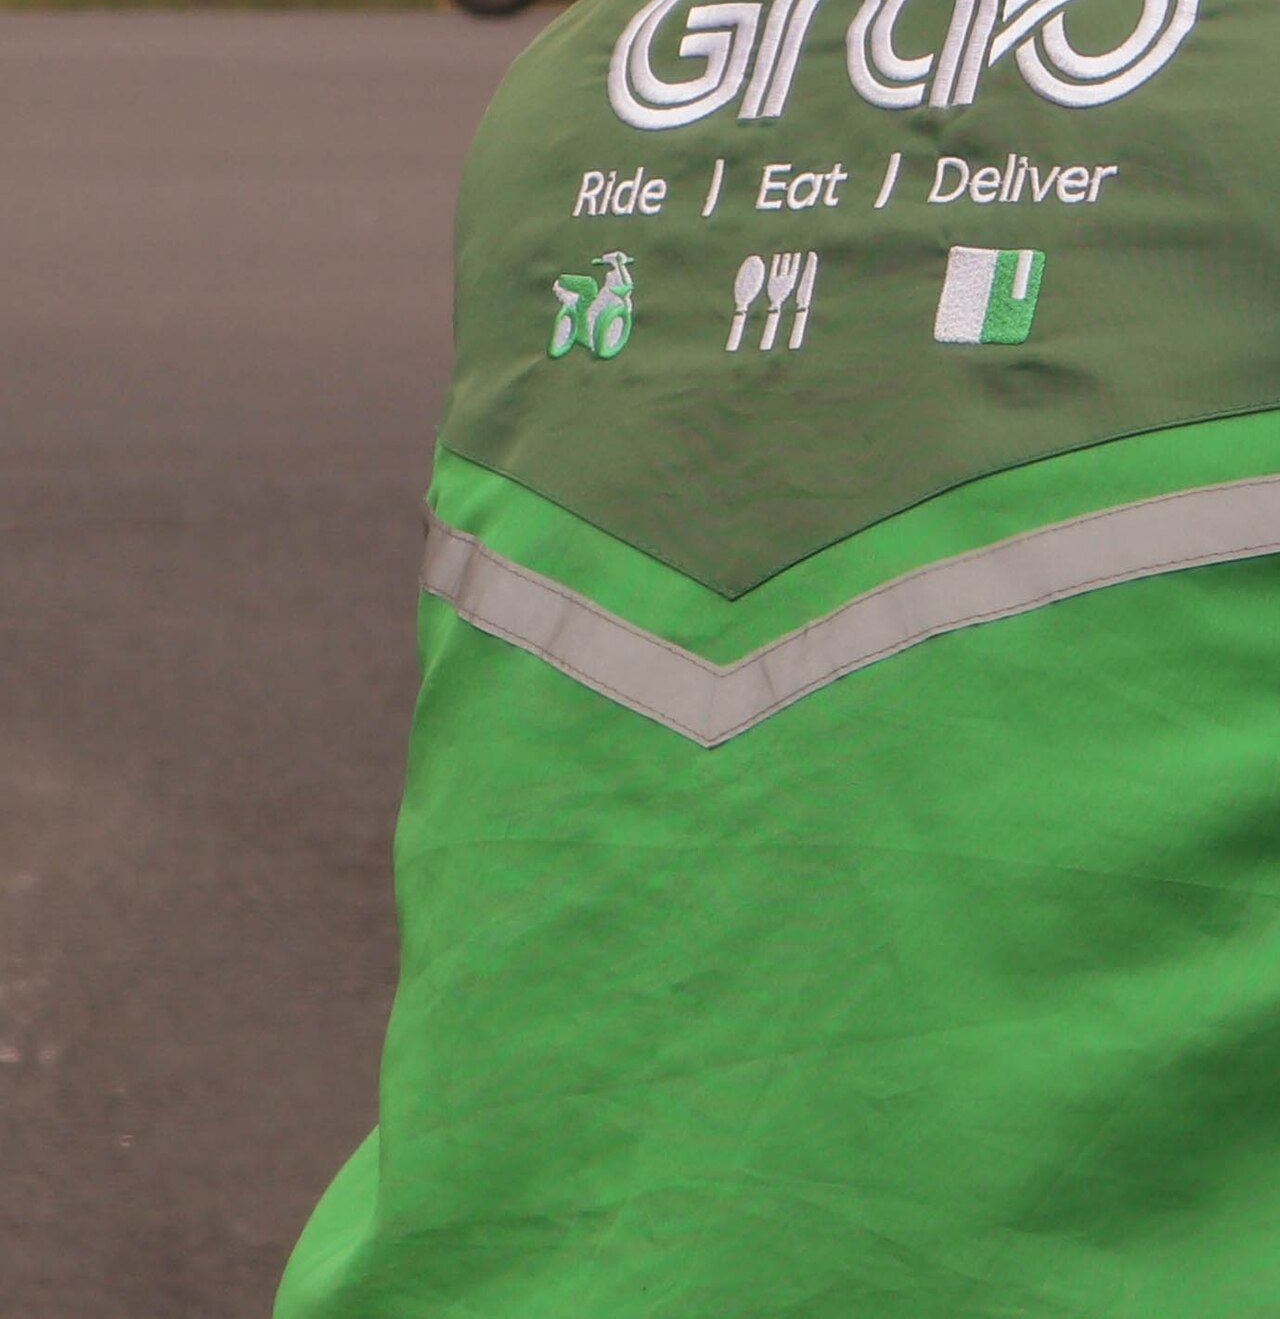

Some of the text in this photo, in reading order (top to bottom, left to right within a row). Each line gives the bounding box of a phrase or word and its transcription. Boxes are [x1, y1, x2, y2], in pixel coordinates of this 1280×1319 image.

[573, 166, 667, 216] Ride
[756, 163, 848, 210] Eat
[928, 153, 1118, 204] Deliver
